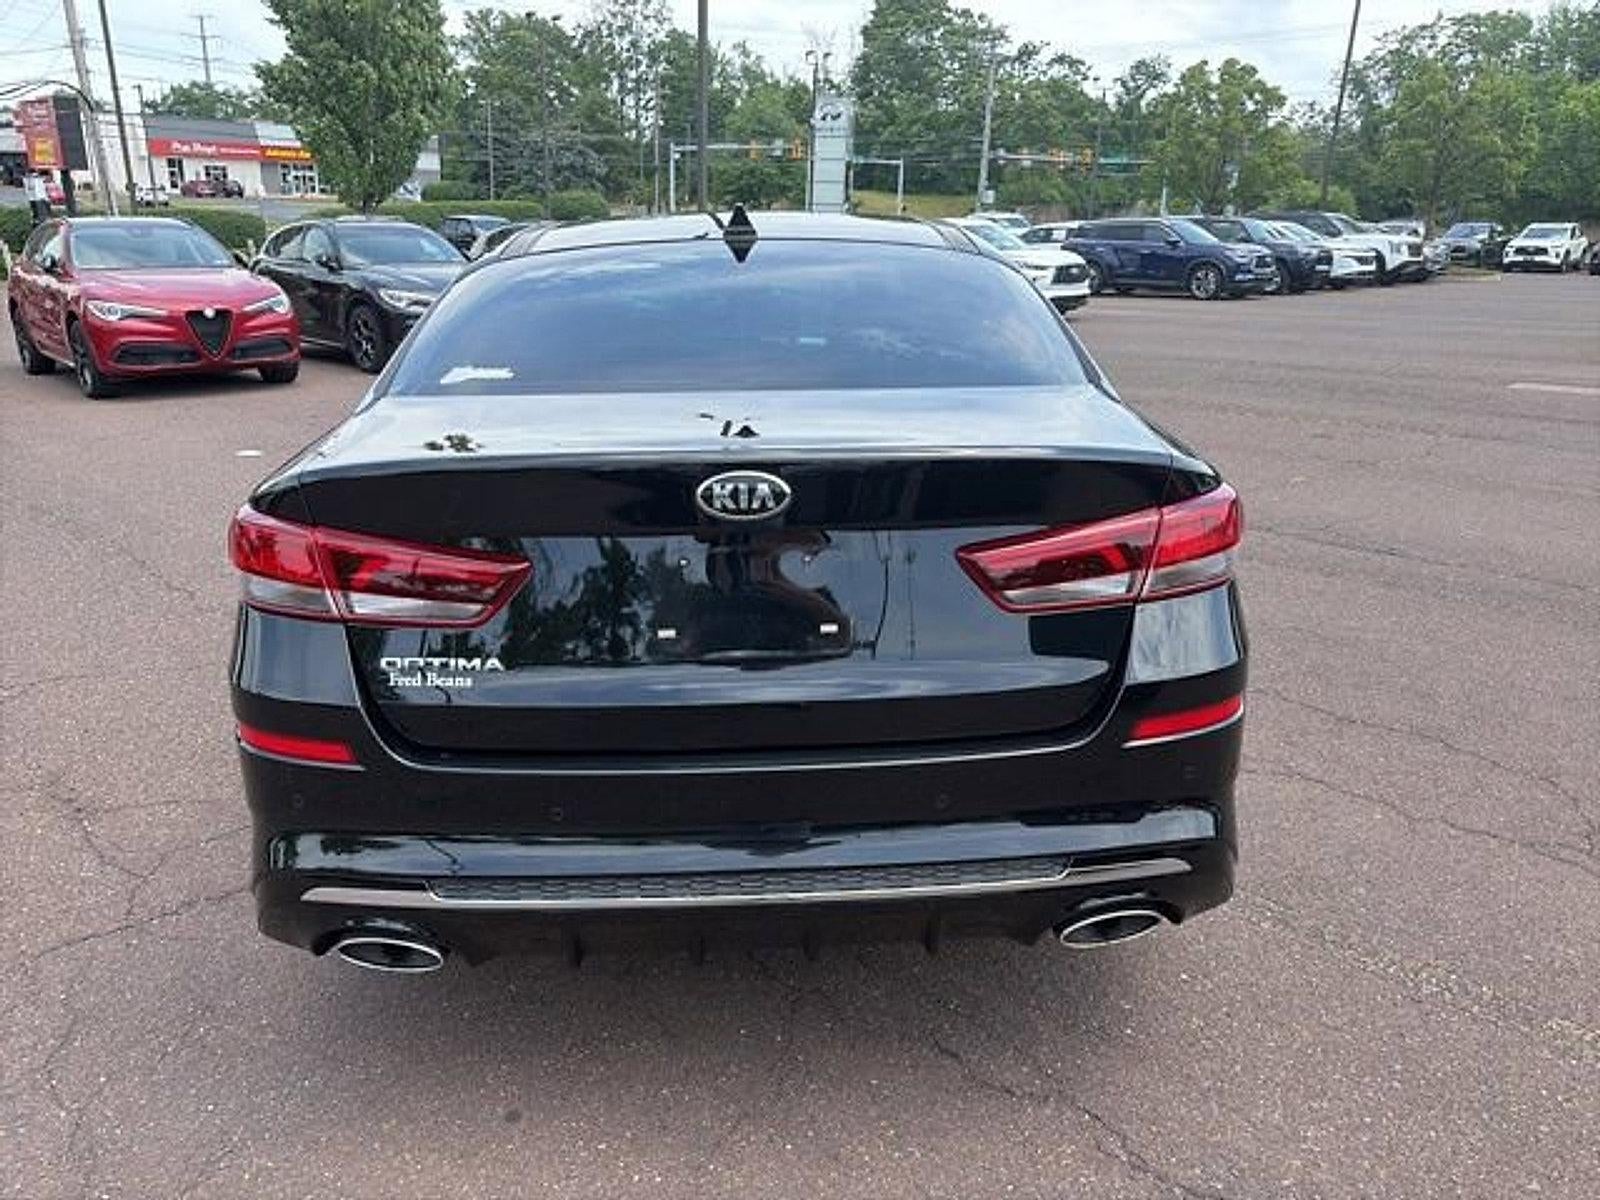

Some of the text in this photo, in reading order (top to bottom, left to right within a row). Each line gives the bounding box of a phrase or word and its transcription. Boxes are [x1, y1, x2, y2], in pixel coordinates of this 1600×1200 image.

[712, 482, 775, 510] KIA
[380, 656, 505, 672] OPTIMA
[387, 671, 473, 687] Fred Beans
